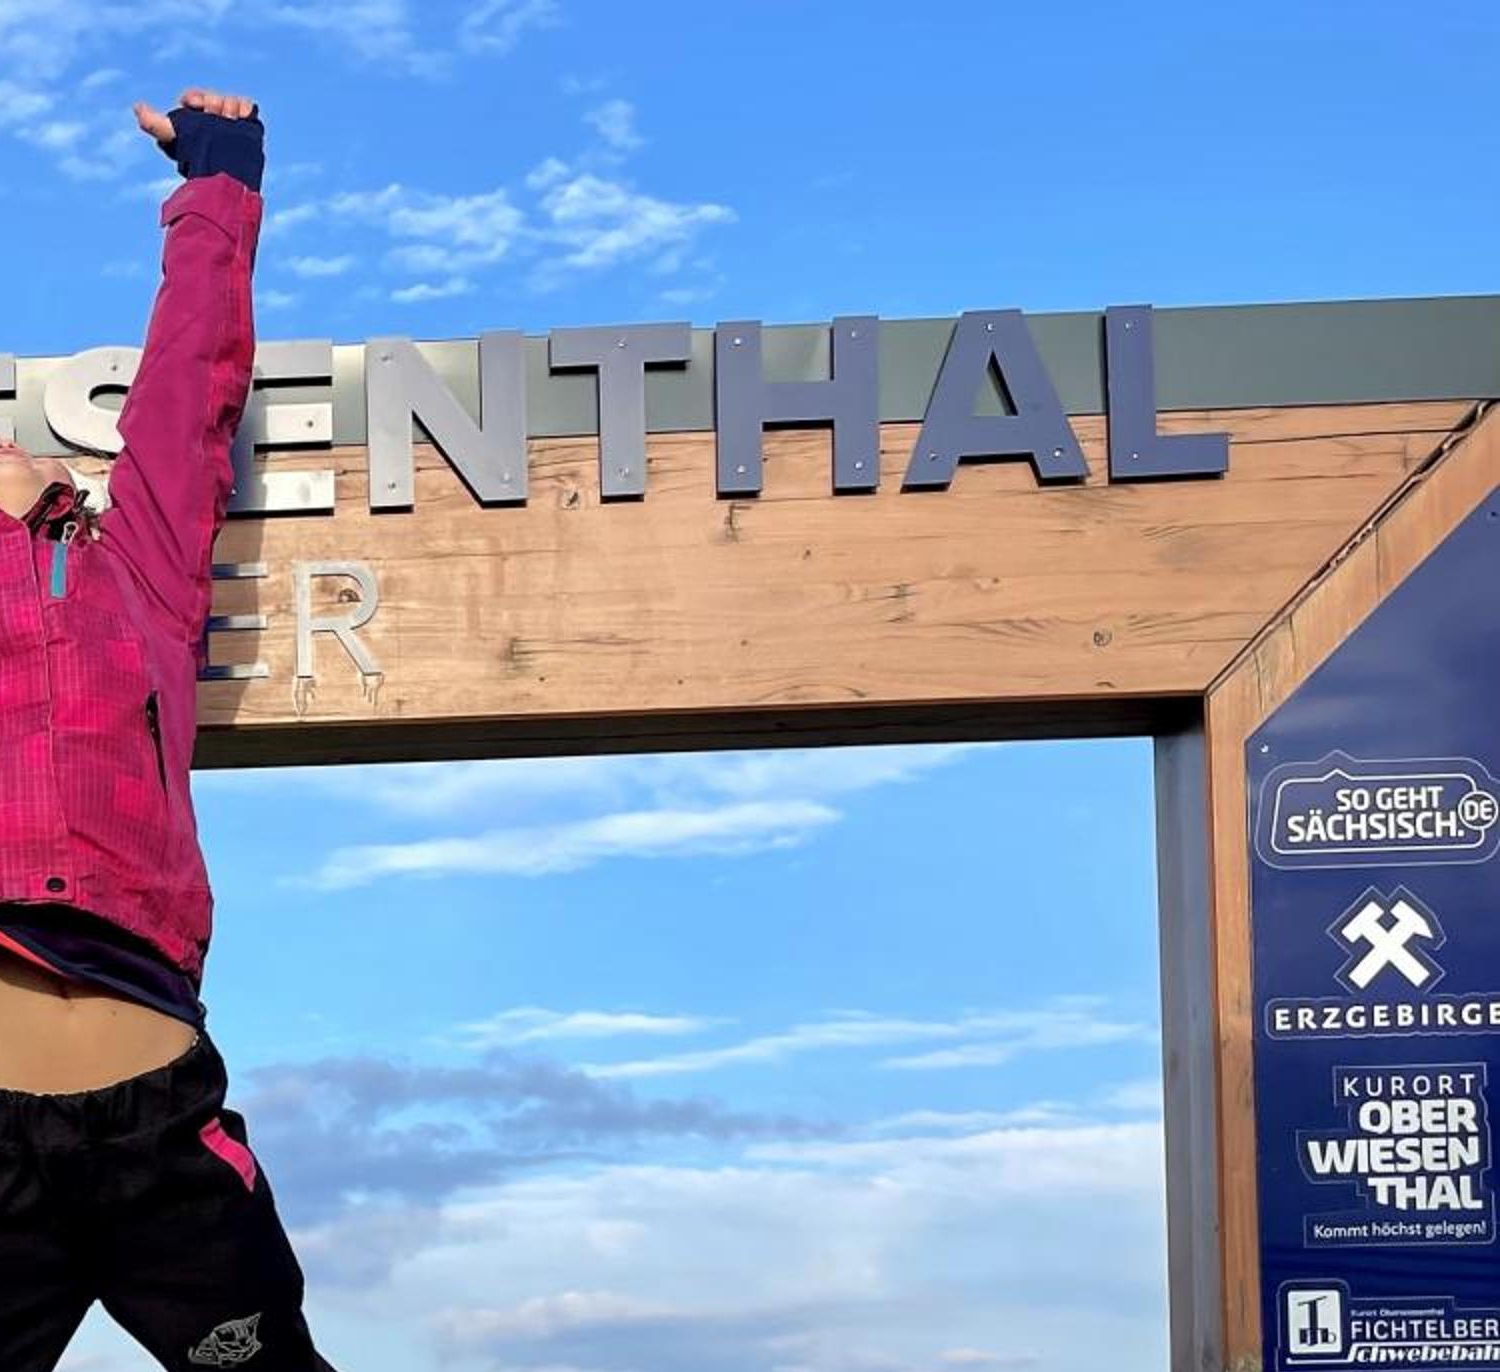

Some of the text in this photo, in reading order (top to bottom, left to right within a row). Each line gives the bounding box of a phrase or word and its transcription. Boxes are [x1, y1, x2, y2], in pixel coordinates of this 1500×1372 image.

[1335, 785, 1444, 812] SO GEHT
[1462, 799, 1494, 822] DE
[1286, 808, 1466, 843] SÄCHSISCH.
[1274, 1003, 1500, 1031] ERZGEBIRGE
[1342, 1073, 1476, 1098] KURORT
[1358, 1098, 1480, 1135] OBER
[1307, 1136, 1481, 1175] WIESEN
[1367, 1175, 1484, 1212] THAL
[1313, 1219, 1486, 1239] Kommt höchst gelegen!
